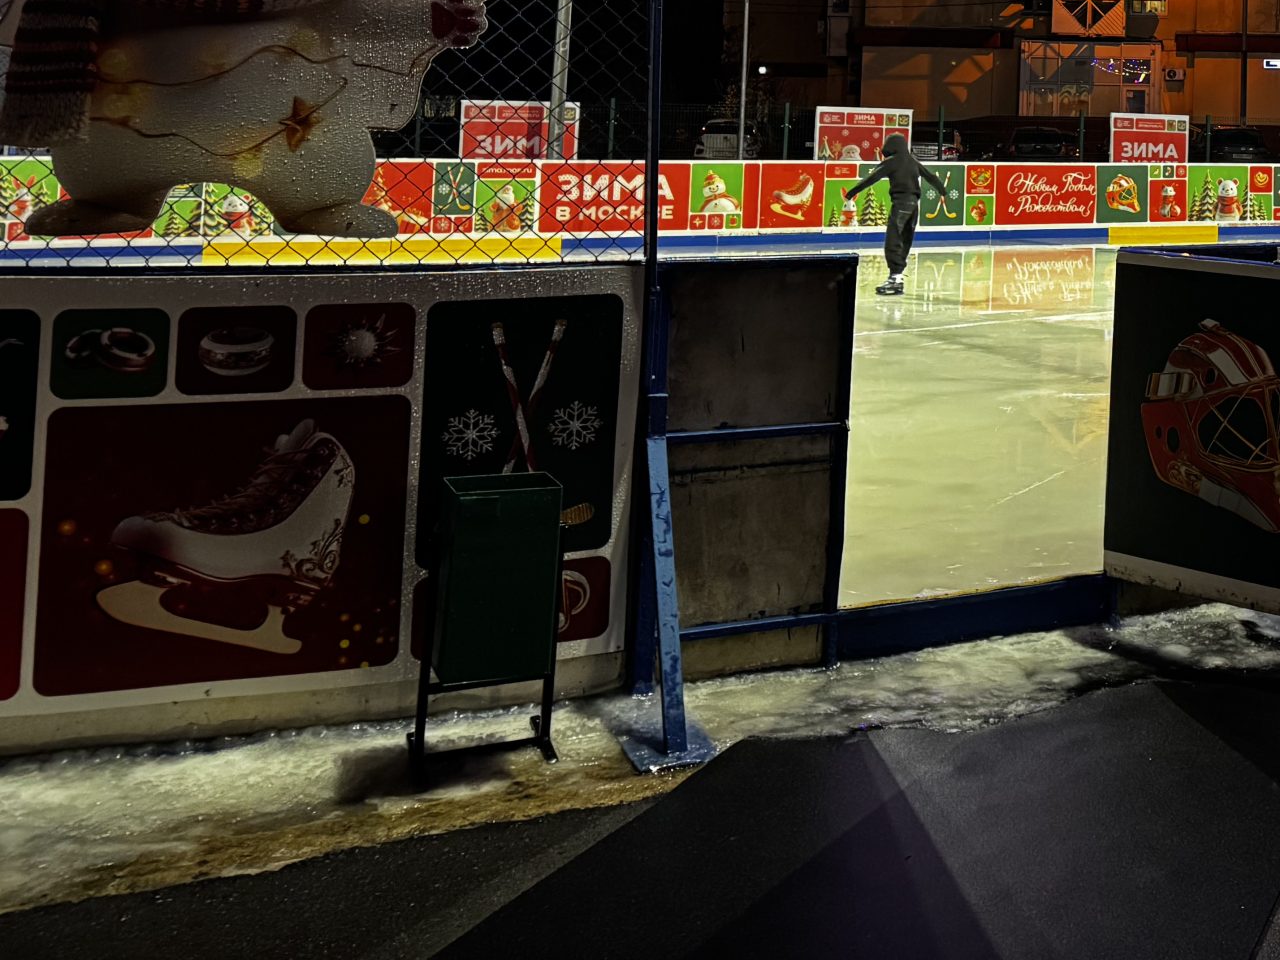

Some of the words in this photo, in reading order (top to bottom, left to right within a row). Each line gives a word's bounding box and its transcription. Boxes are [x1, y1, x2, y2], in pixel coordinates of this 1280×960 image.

[475, 135, 548, 155] ЗИМ
[1121, 141, 1178, 159] ЗИМА
[556, 173, 674, 202] ЗИМА
[556, 206, 571, 221] В
[580, 205, 674, 221] МОСКЕ
